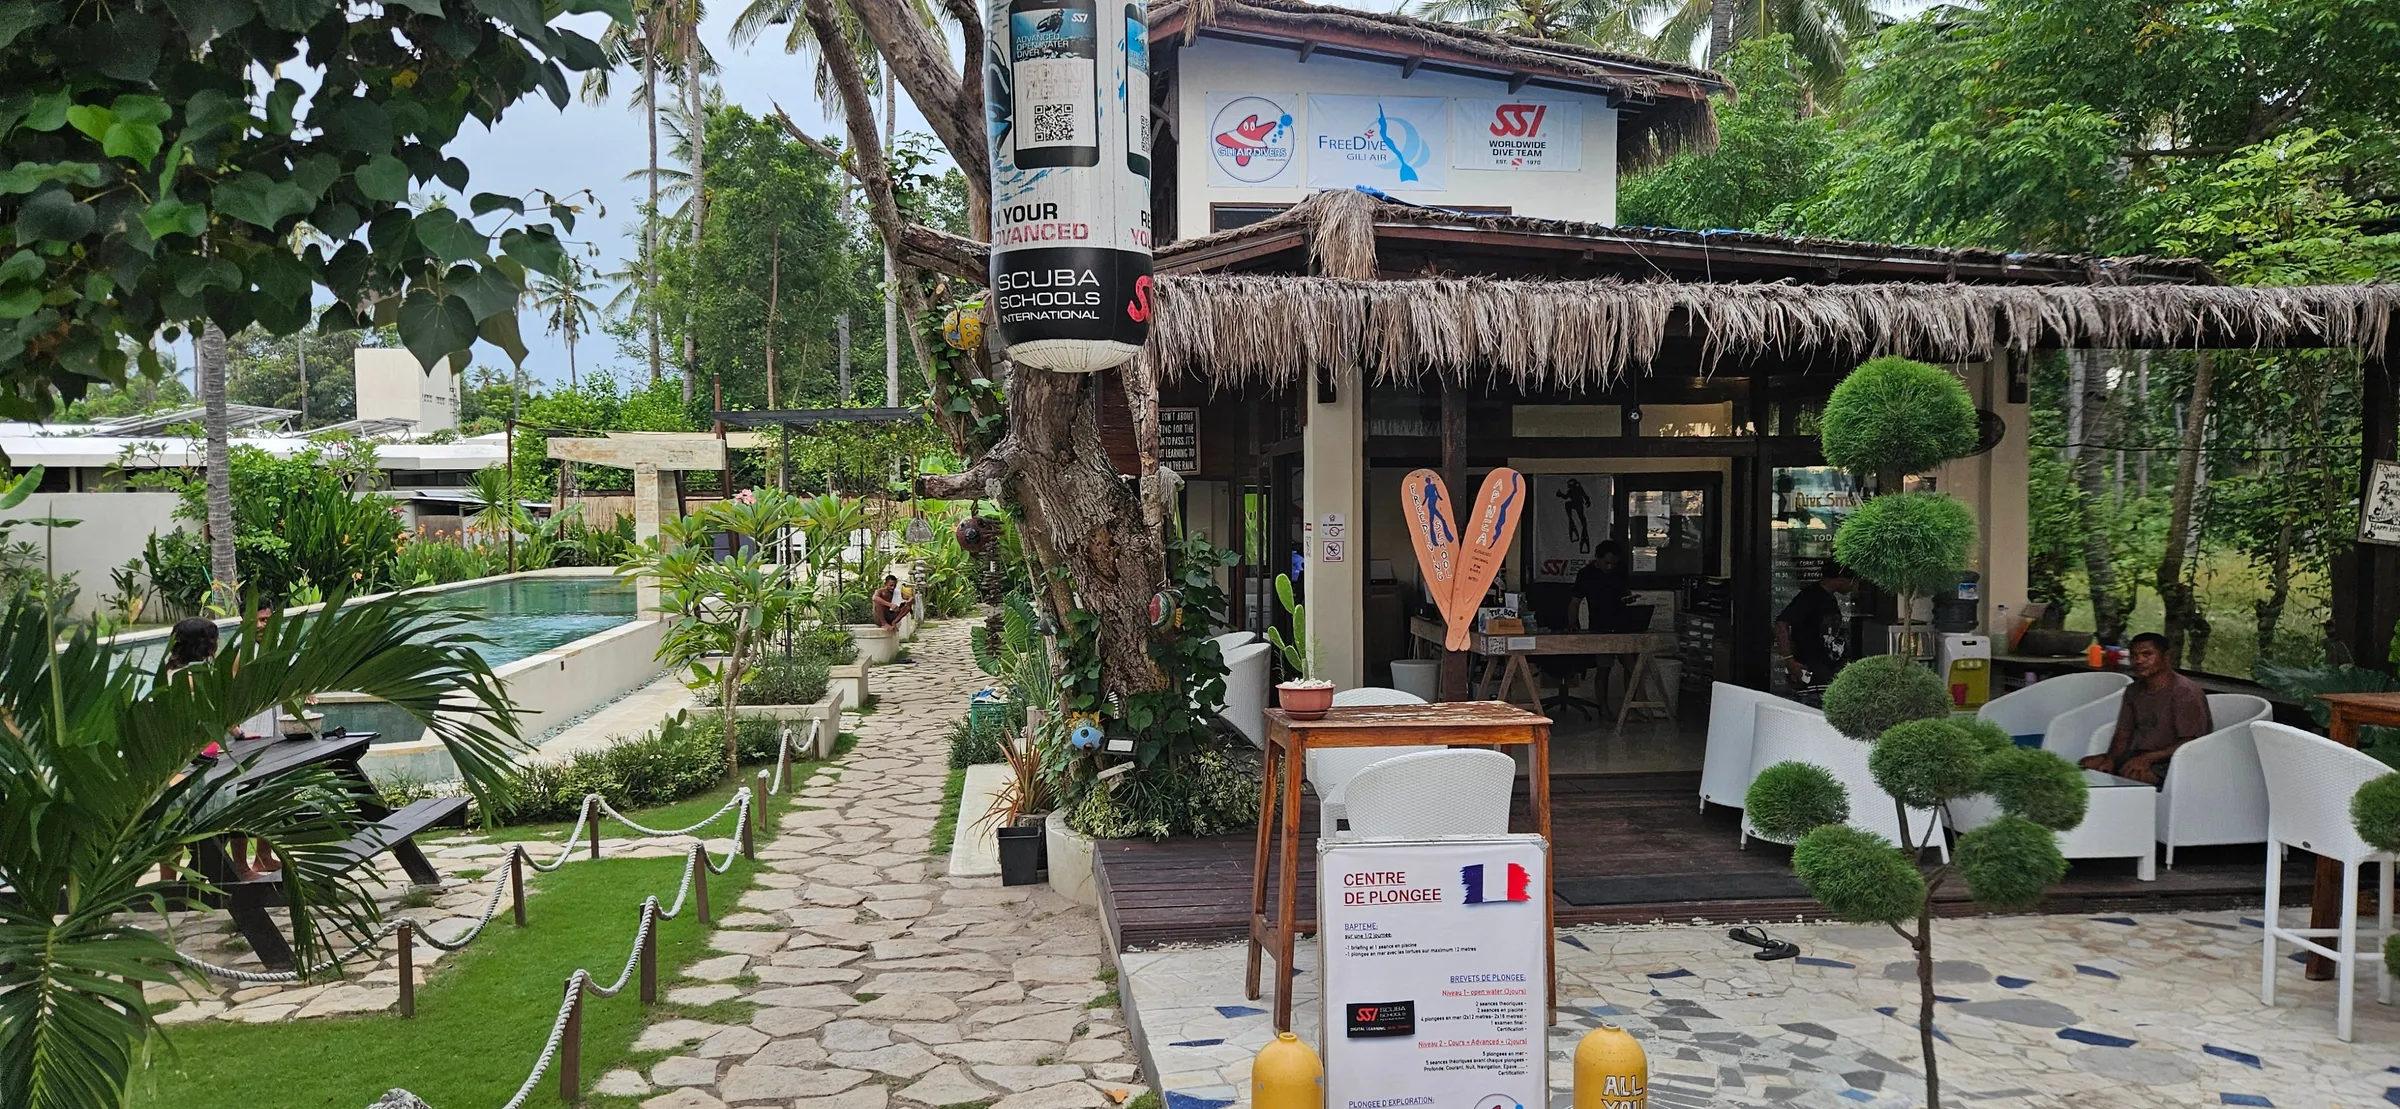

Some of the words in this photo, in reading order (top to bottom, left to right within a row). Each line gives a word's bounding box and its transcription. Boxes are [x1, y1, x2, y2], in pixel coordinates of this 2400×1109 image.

[1071, 13, 1088, 23] SSI
[1016, 33, 1060, 44] ADVANCED
[1016, 42, 1037, 51] OPEN
[1038, 40, 1069, 49] WATER
[1016, 49, 1039, 59] DIVER
[1489, 104, 1547, 137] SSI
[1489, 140, 1547, 149] WORLDWIDE
[1237, 147, 1252, 157] AIR
[1253, 147, 1287, 157] DIVERS
[1346, 153, 1367, 161] GILI
[1516, 149, 1542, 157] TEAM
[1003, 203, 1058, 225] YOUR
[994, 223, 1089, 249] DVANCED
[998, 269, 1100, 291] SCUBA
[1000, 291, 1101, 310] SCHOOLS
[1002, 310, 1100, 323] INTERNATIONAL
[1177, 411, 1194, 421] ABOUT
[1173, 424, 1183, 434] FOR
[1184, 423, 1194, 433] THE
[1166, 437, 1172, 446] TO
[1165, 448, 1188, 458] LEARNING
[1189, 448, 1195, 458] TO
[1475, 478, 1503, 546] APNEA
[1434, 521, 1452, 579] SCHOOL
[1541, 559, 1569, 576] SSI
[1489, 609, 1501, 617] TIP
[1503, 609, 1517, 617] BOX
[1343, 871, 1406, 887] CENTRE
[1344, 891, 1365, 905] DE
[1369, 888, 1441, 904] PLONGEE
[1450, 974, 1480, 983] BREVETS
[1481, 974, 1491, 982] DE
[1356, 1007, 1379, 1021] SSI
[1471, 1038, 1499, 1046] Advanced
[1602, 1074, 1644, 1097] ALL
[1348, 1099, 1380, 1109] PLONGEE
